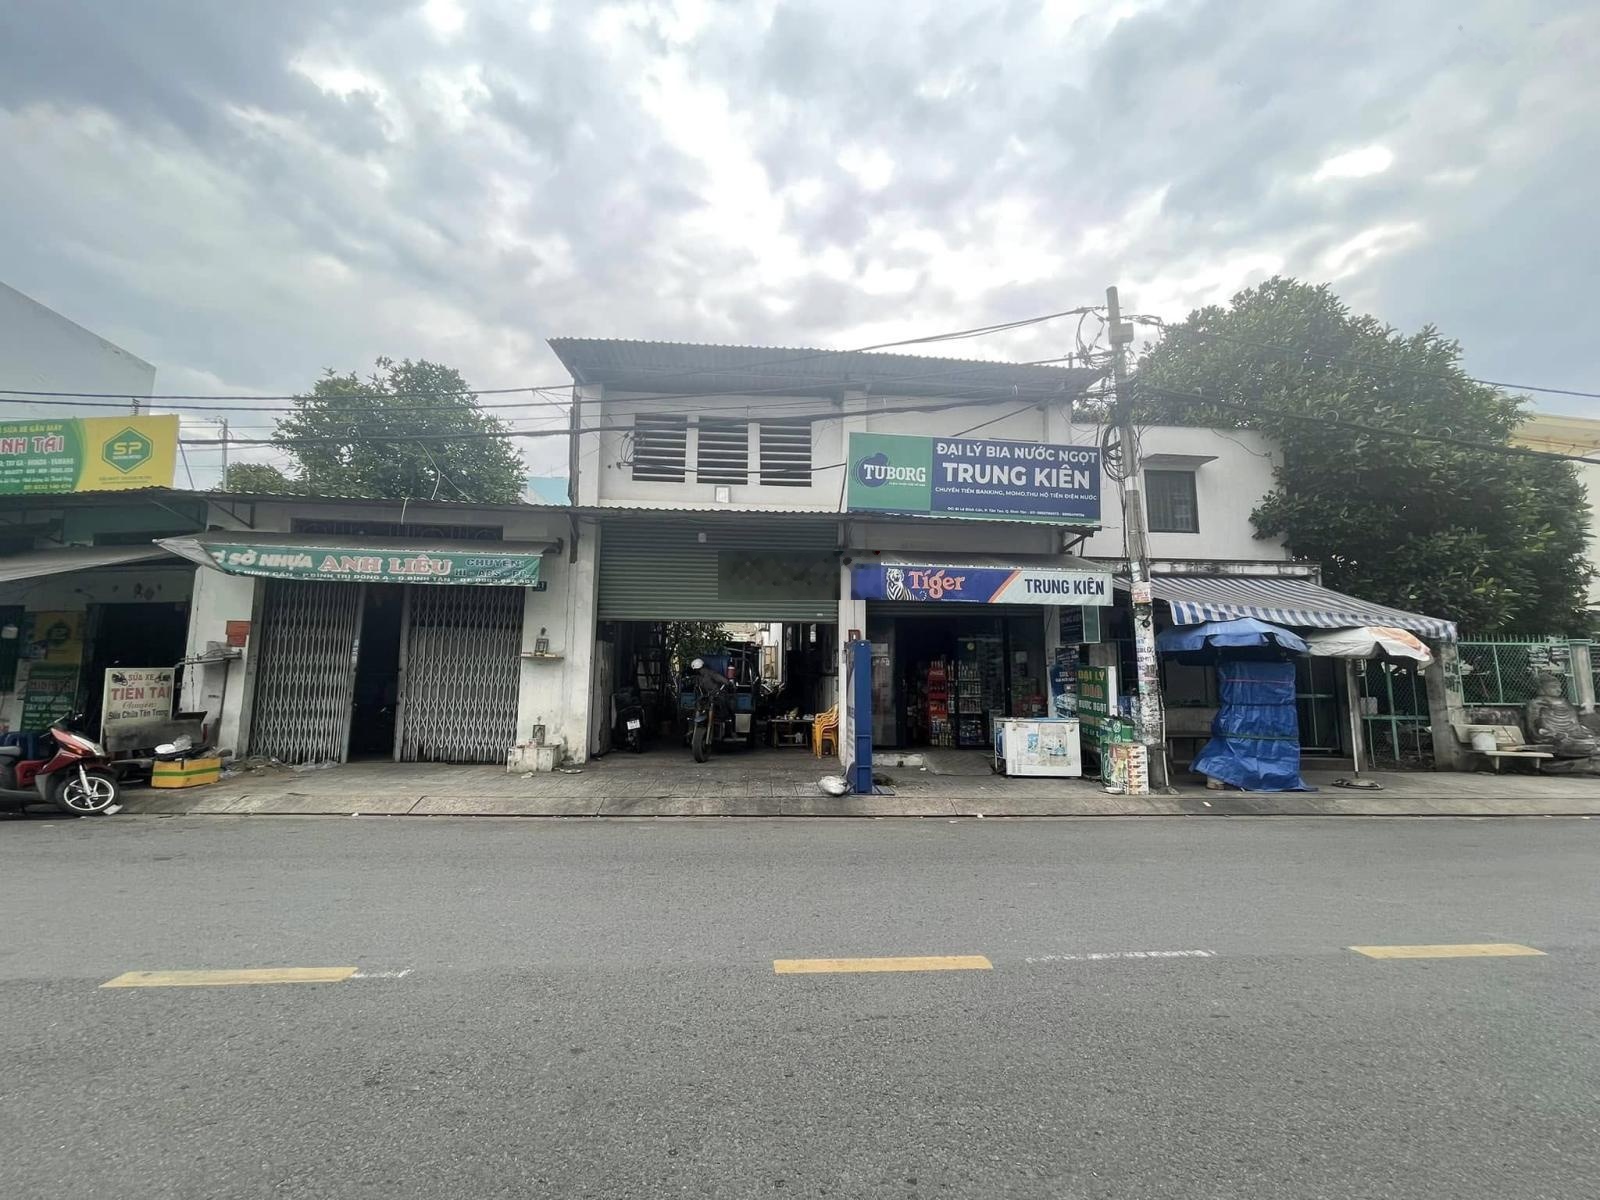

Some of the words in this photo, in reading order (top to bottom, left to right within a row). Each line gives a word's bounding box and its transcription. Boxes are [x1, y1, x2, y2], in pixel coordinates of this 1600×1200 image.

[113, 442, 142, 455] SP
[936, 443, 962, 458] ĐẠI
[966, 442, 983, 457] LÝ
[986, 446, 1011, 458] BIA
[1014, 445, 1055, 460] NƯỚC
[1059, 450, 1097, 466] NGỌT
[864, 464, 926, 482] TUBORG
[943, 462, 1027, 486] TRUNG
[1034, 464, 1090, 490] KIÊN
[228, 549, 257, 566] SỞ
[259, 552, 313, 571] NHỰA
[318, 555, 382, 574] ANH
[388, 554, 453, 576] LIÊU
[908, 570, 965, 599] Tiger
[1024, 578, 1070, 594] TRUNG
[1073, 577, 1105, 595] KIÊN
[145, 673, 155, 681] XE
